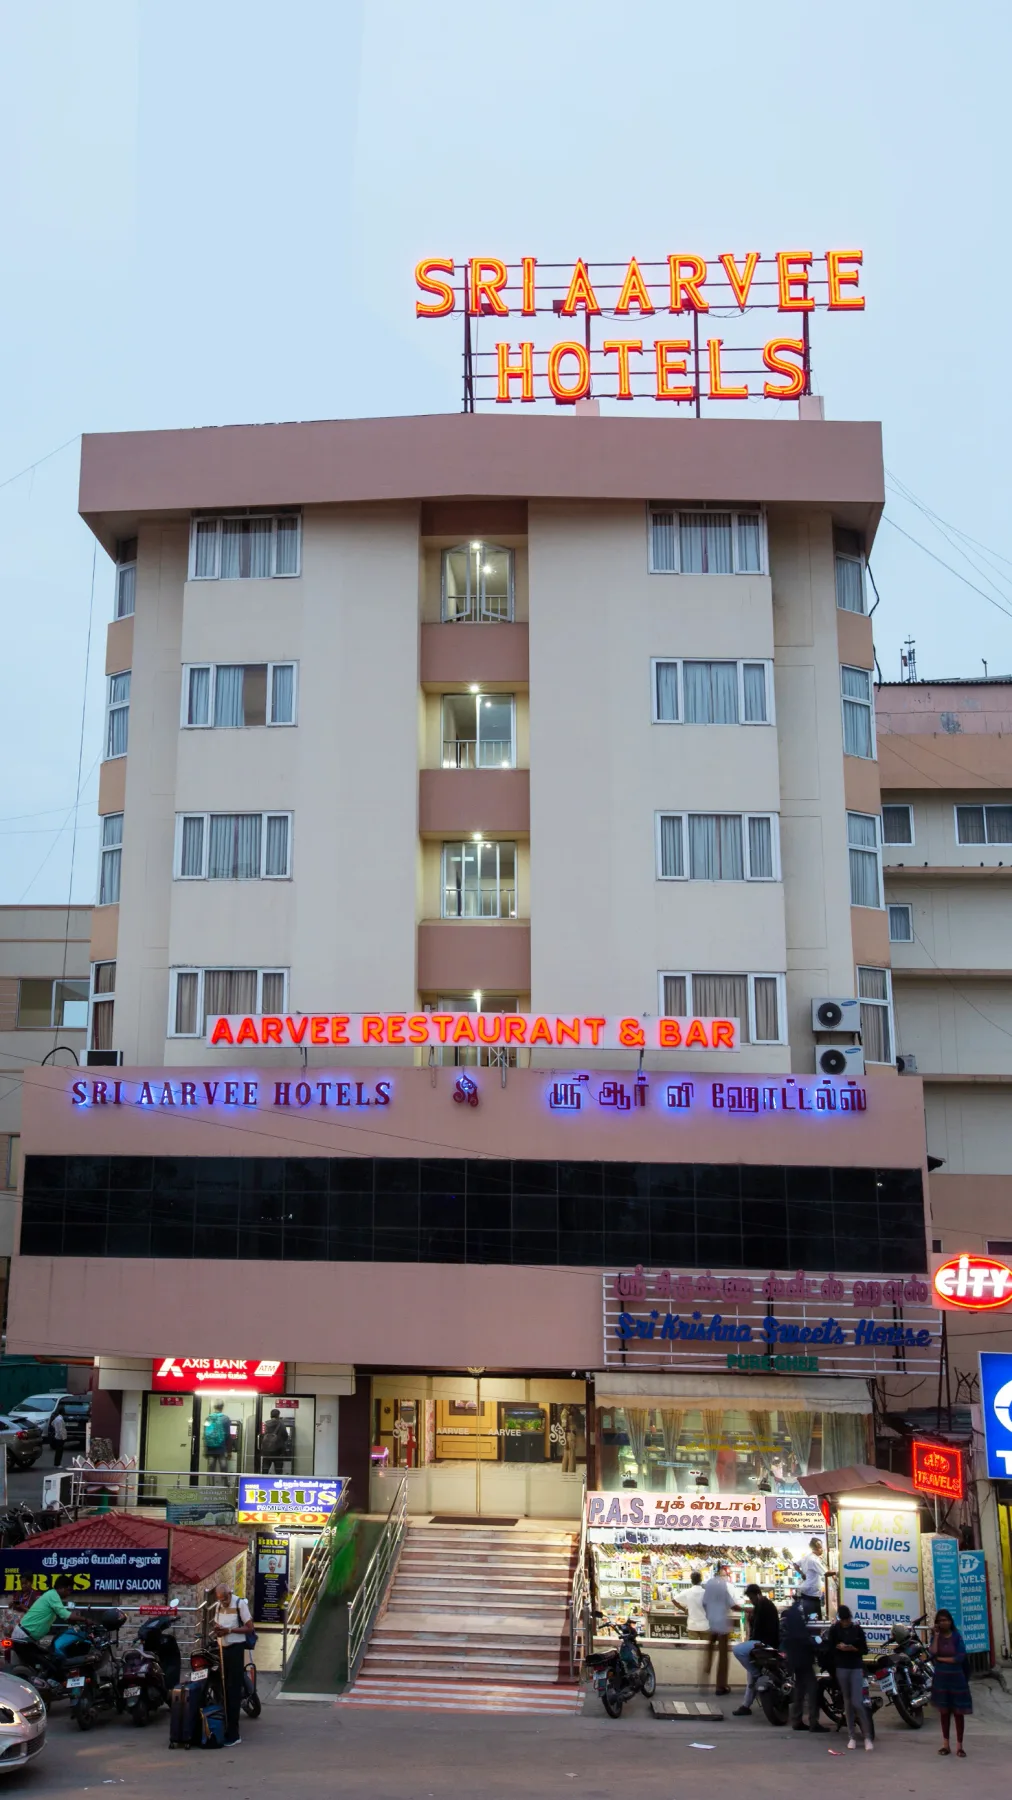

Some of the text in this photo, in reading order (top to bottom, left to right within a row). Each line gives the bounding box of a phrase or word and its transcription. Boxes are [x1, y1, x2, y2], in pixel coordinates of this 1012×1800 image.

[415, 249, 866, 318] SRI AARVEE
[494, 337, 808, 403] HOTELS
[210, 1015, 736, 1049] AARVEE RESTAURANT & BAR
[72, 1081, 391, 1107] SRI AARVEE HOTELS
[598, 1075, 650, 1110] ஆர்
[666, 1082, 695, 1108] வி
[615, 1311, 933, 1347] Sri Krishna Sweets House
[182, 1358, 276, 1372] AXIS BANK ATM
[436, 1427, 470, 1435] AARVEE
[488, 1428, 522, 1436] AARVEE
[917, 1470, 960, 1491] TRAVELS
[244, 1489, 337, 1506] BRUS
[655, 1496, 761, 1513] புக் ஸ்டால்
[256, 1504, 287, 1512] FAMILY
[589, 1497, 650, 1524] P.A.S.
[654, 1513, 762, 1528] BOOK STALL
[851, 1512, 909, 1534] P.A.S.
[258, 1538, 289, 1546] BRUS
[849, 1535, 911, 1552] Mobiles
[94, 1578, 124, 1590] FAMILY
[126, 1579, 162, 1590] SALOON
[854, 1611, 911, 1623] ALL MOBILES
